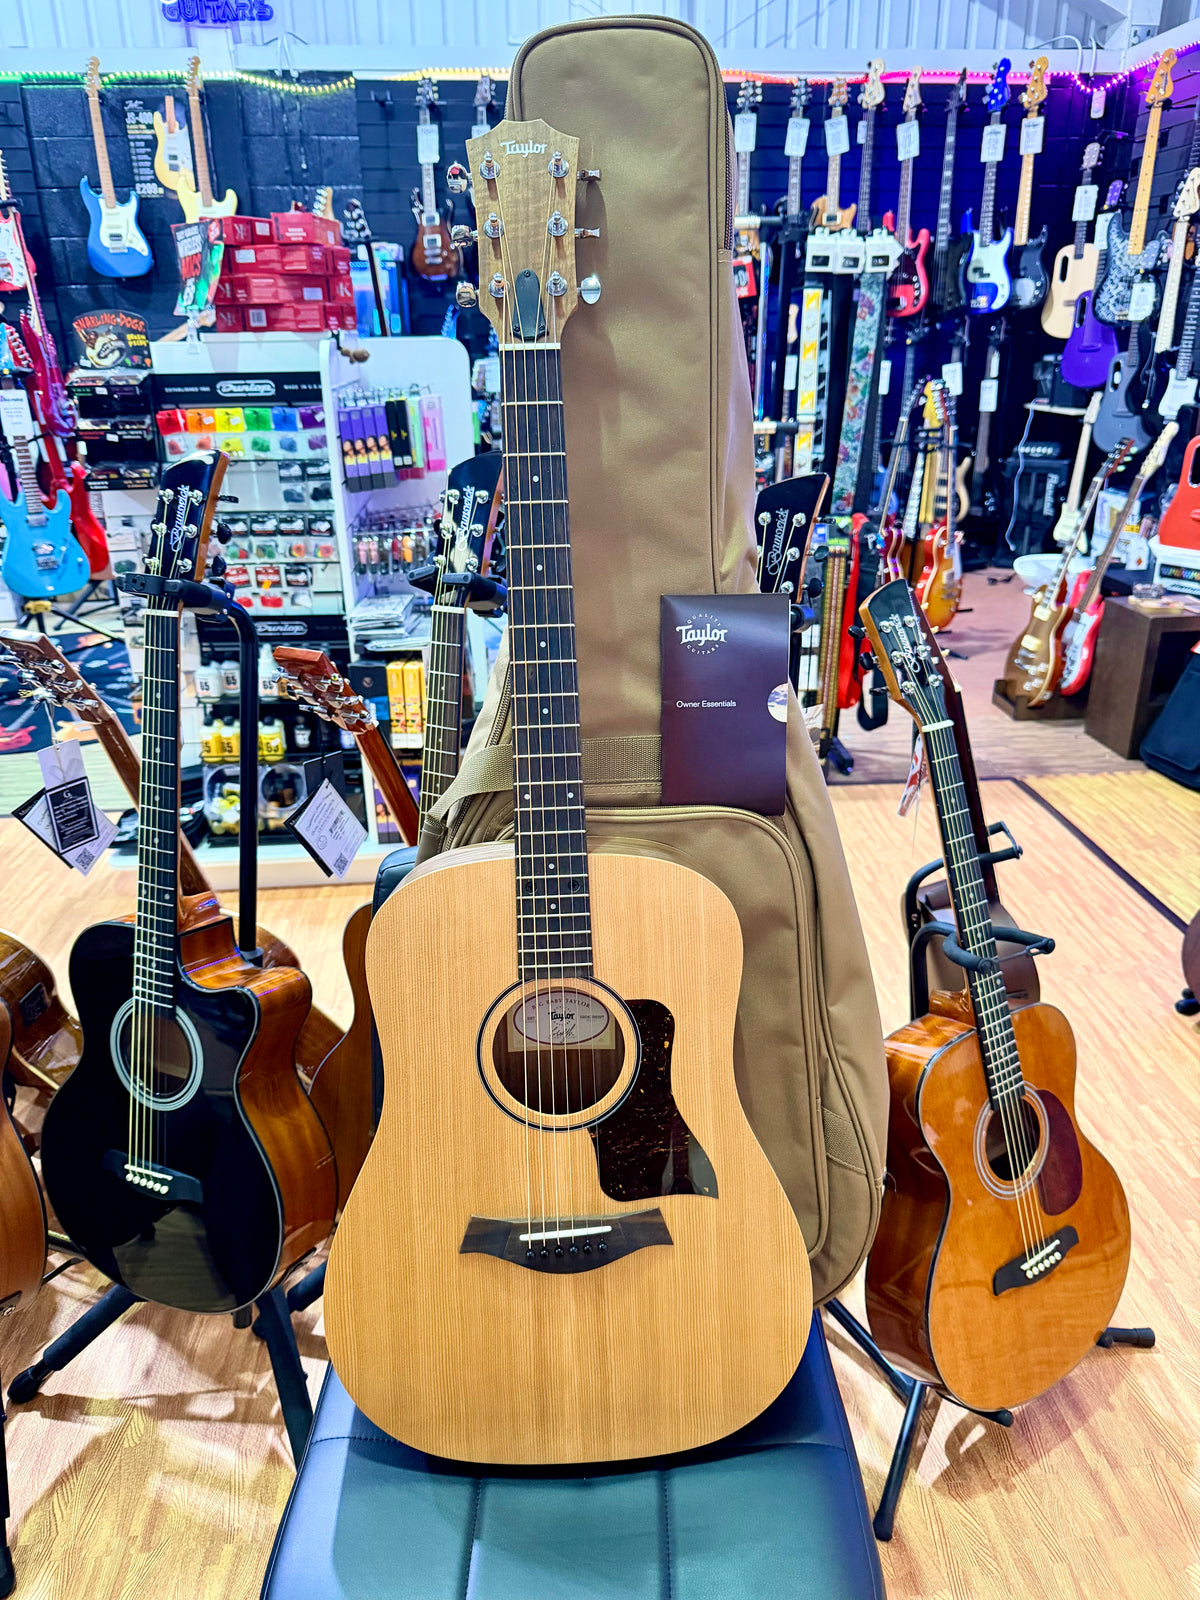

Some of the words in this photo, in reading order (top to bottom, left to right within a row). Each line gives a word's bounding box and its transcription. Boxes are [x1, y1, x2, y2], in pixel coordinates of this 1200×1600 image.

[499, 139, 548, 158] Taylor
[72, 313, 117, 331] SNARLING
[220, 382, 272, 394] Dunlop
[169, 484, 190, 552] Brunswick
[454, 485, 475, 552] Brunswick
[765, 507, 789, 576] Brunswick
[257, 623, 304, 633] Dunlop
[675, 623, 728, 647] Taylor
[676, 700, 700, 709] Owner
[701, 700, 737, 708] Essentials
